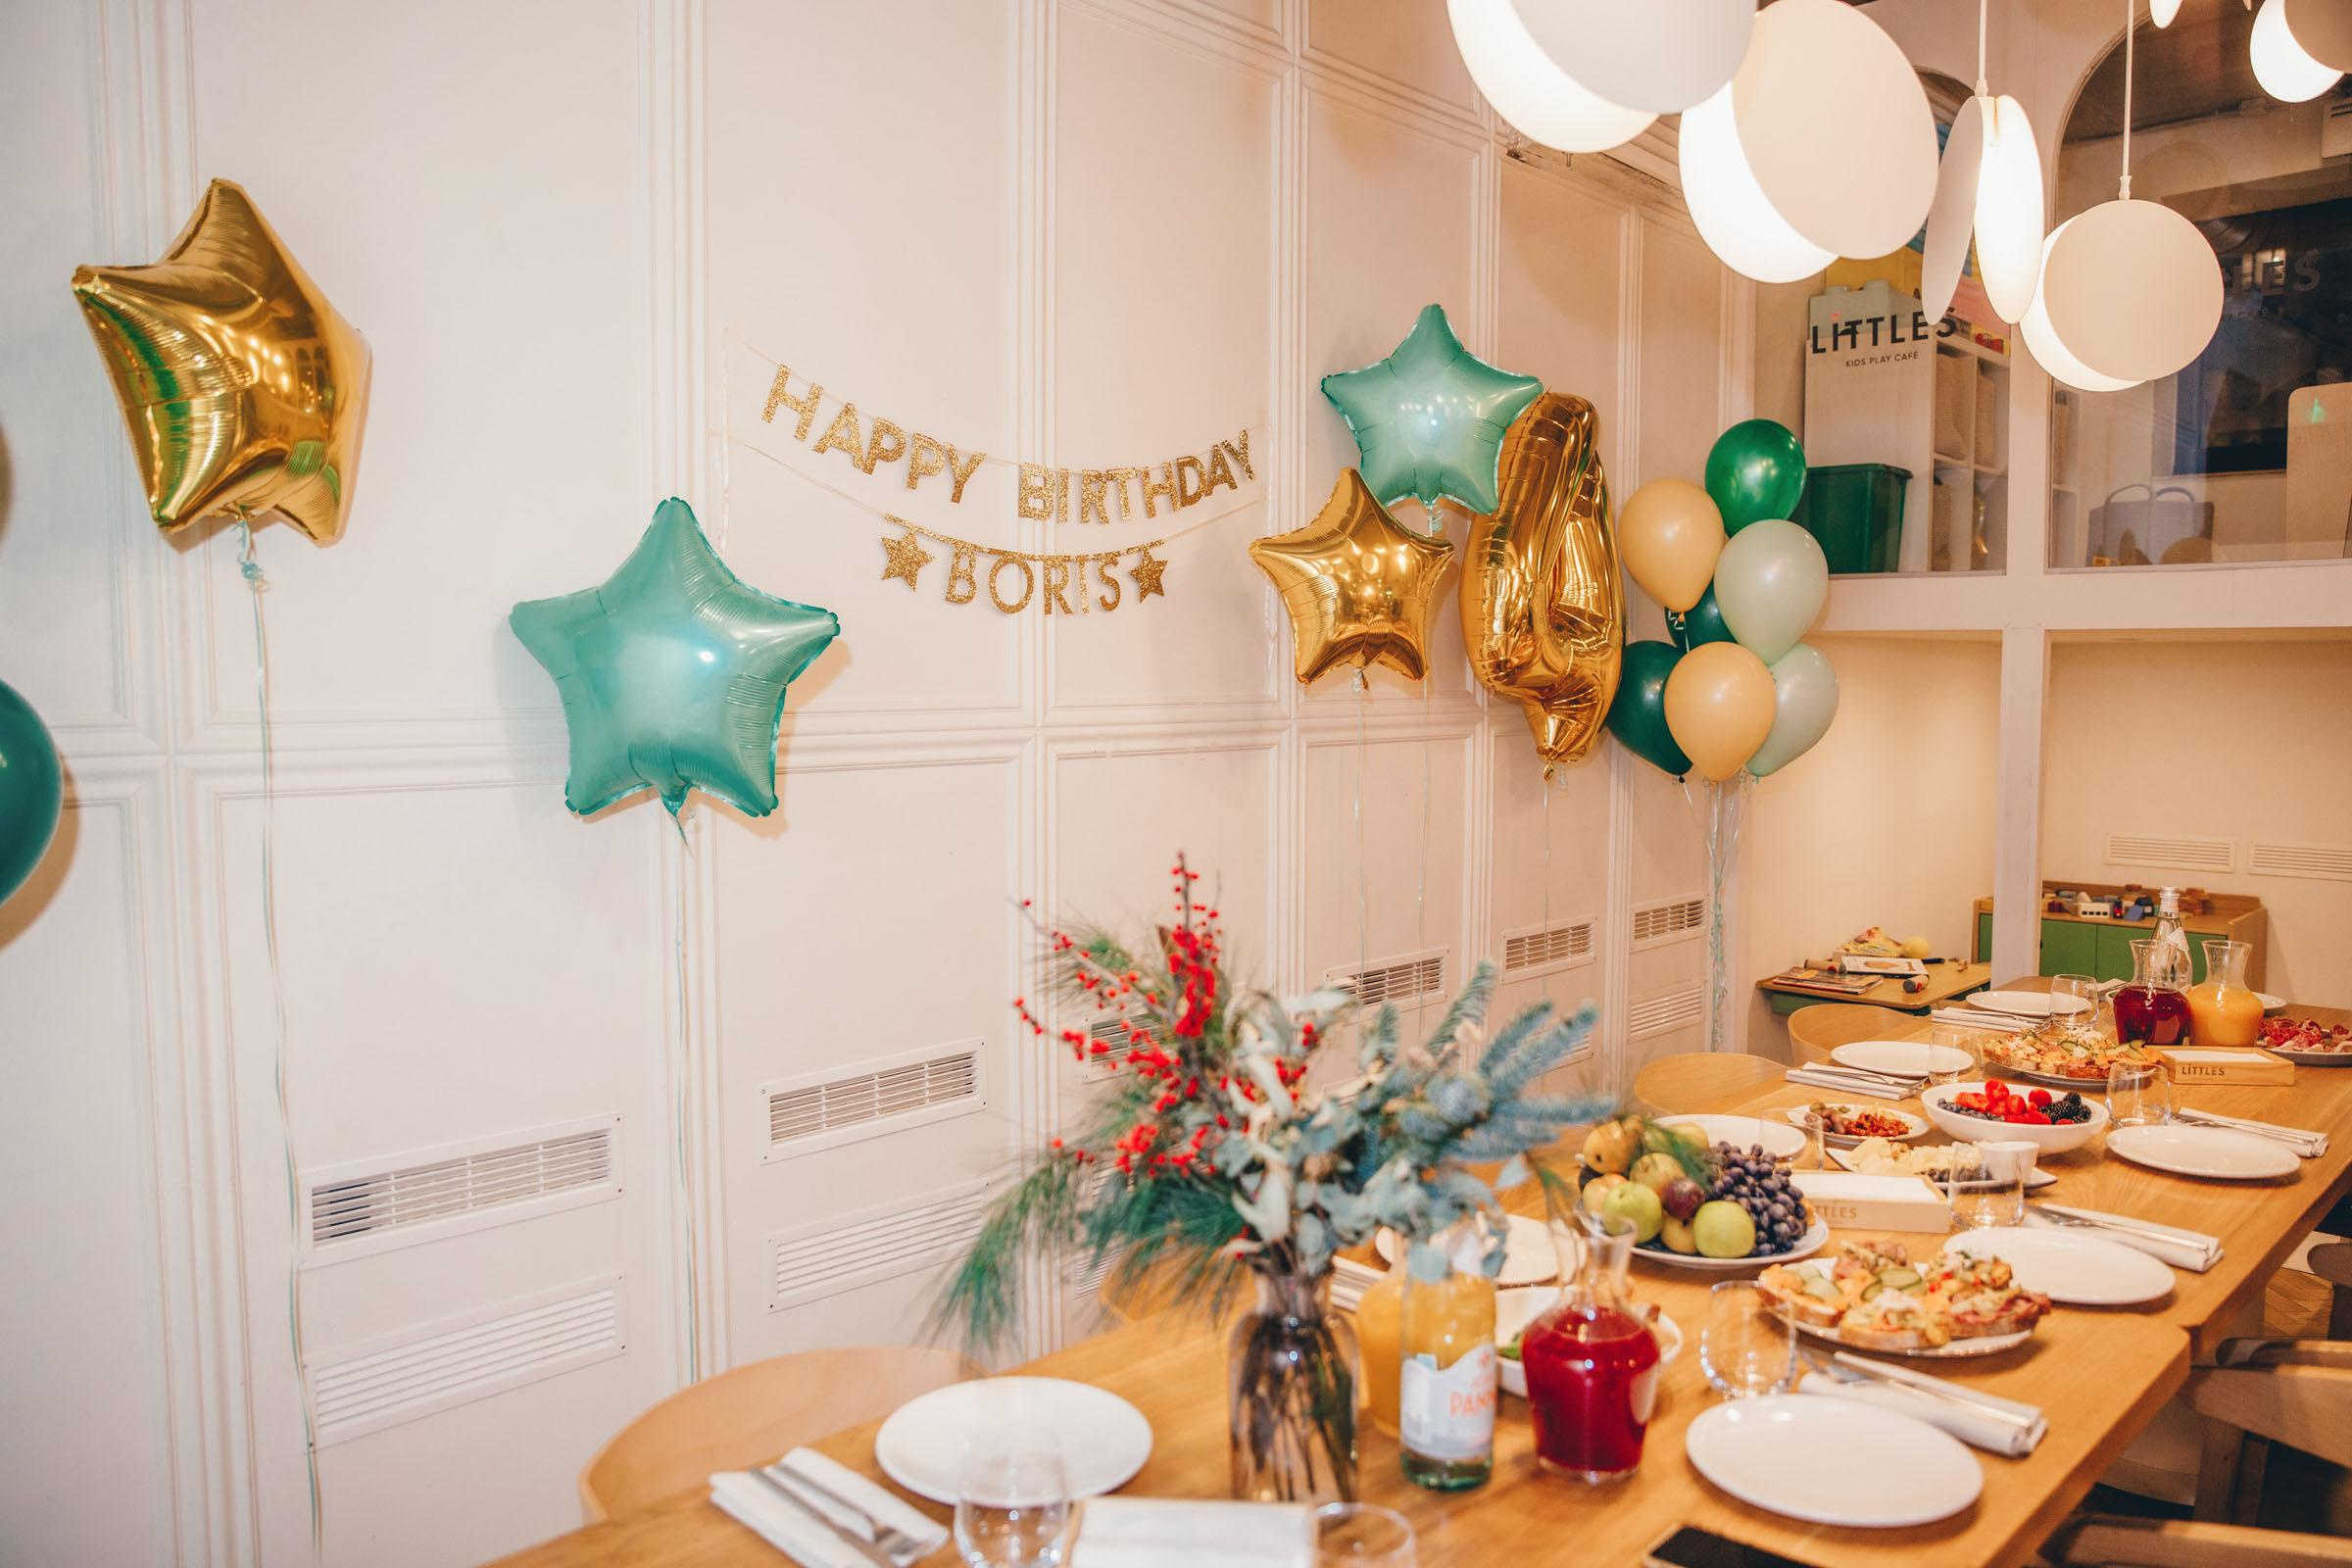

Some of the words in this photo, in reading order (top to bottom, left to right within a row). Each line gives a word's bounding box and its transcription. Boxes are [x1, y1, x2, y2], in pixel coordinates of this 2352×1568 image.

[1844, 357, 1866, 368] KIDS
[1869, 355, 1891, 365] PLAY
[760, 364, 987, 505] HAPPY
[1017, 429, 1256, 524] BIRTHDAY
[945, 544, 1122, 616] BORIS
[1813, 1205, 1857, 1219] TTLES
